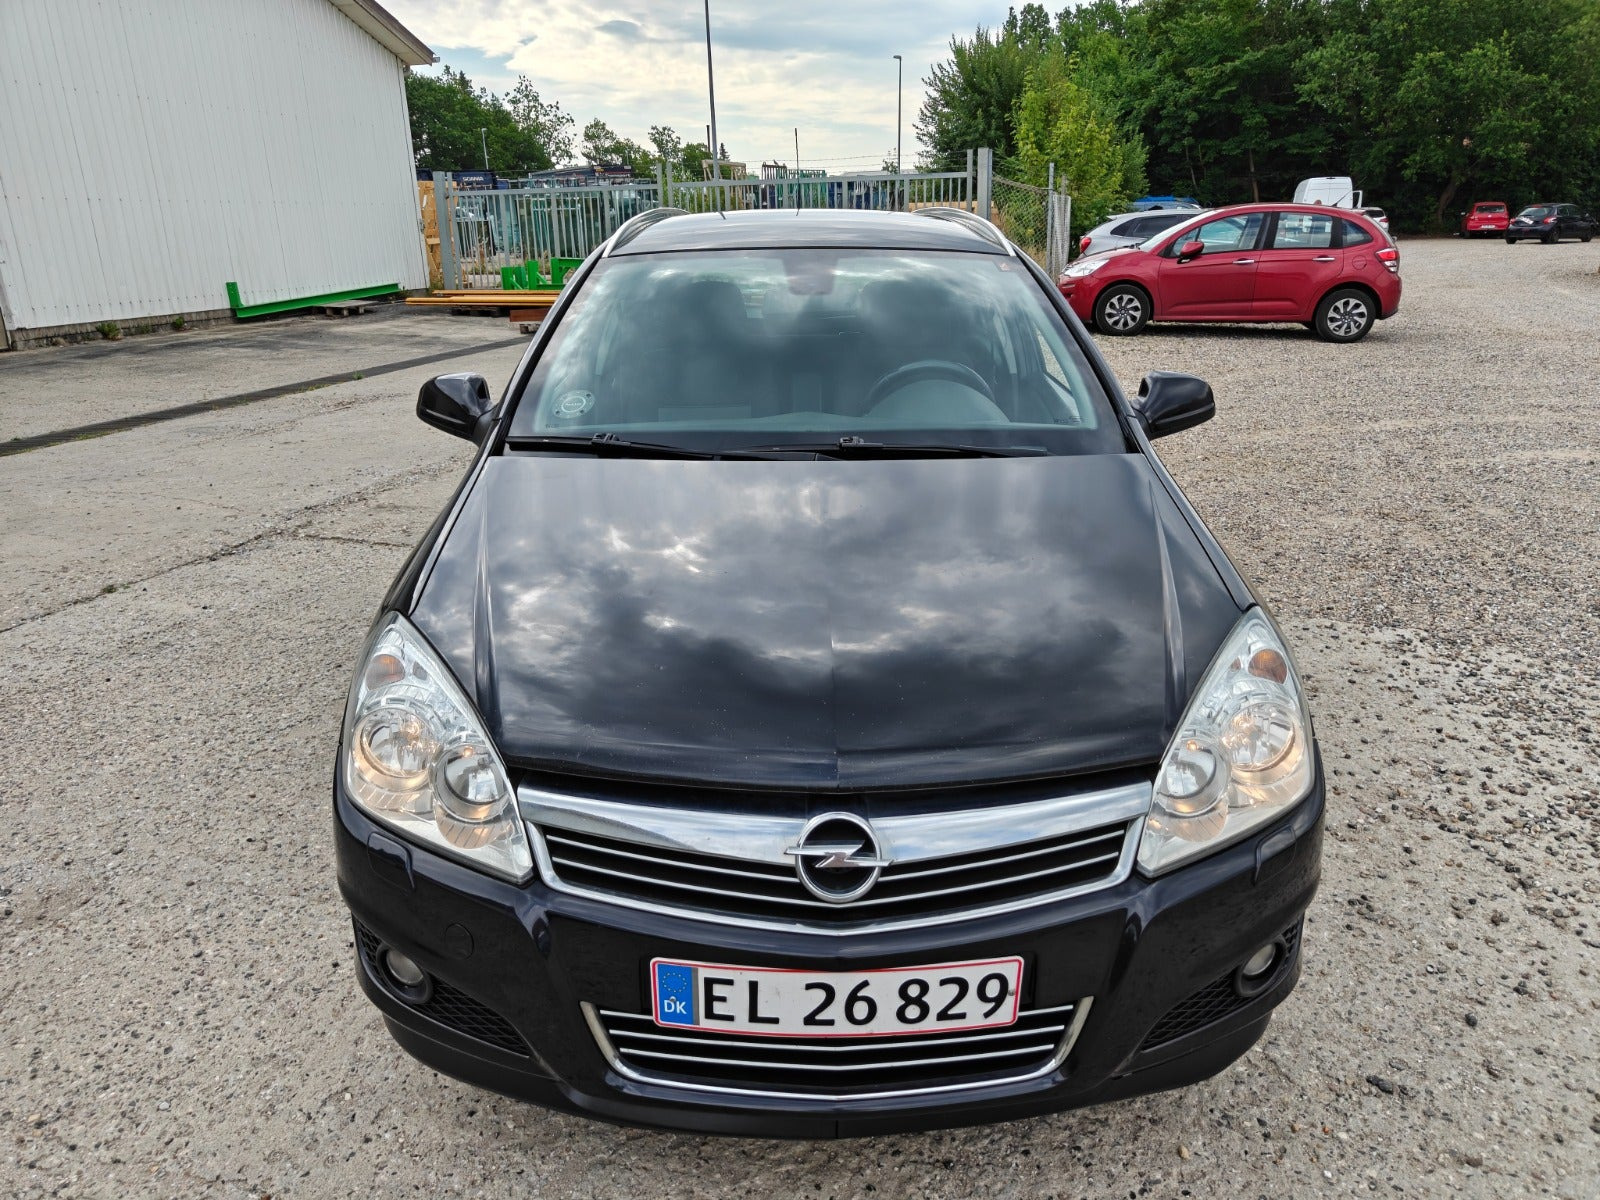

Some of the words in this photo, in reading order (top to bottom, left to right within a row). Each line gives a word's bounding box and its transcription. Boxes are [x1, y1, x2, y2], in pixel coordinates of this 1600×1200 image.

[664, 999, 687, 1014] DK
[703, 976, 780, 1025] EL
[803, 979, 878, 1026] 26
[896, 972, 1009, 1025] 829
